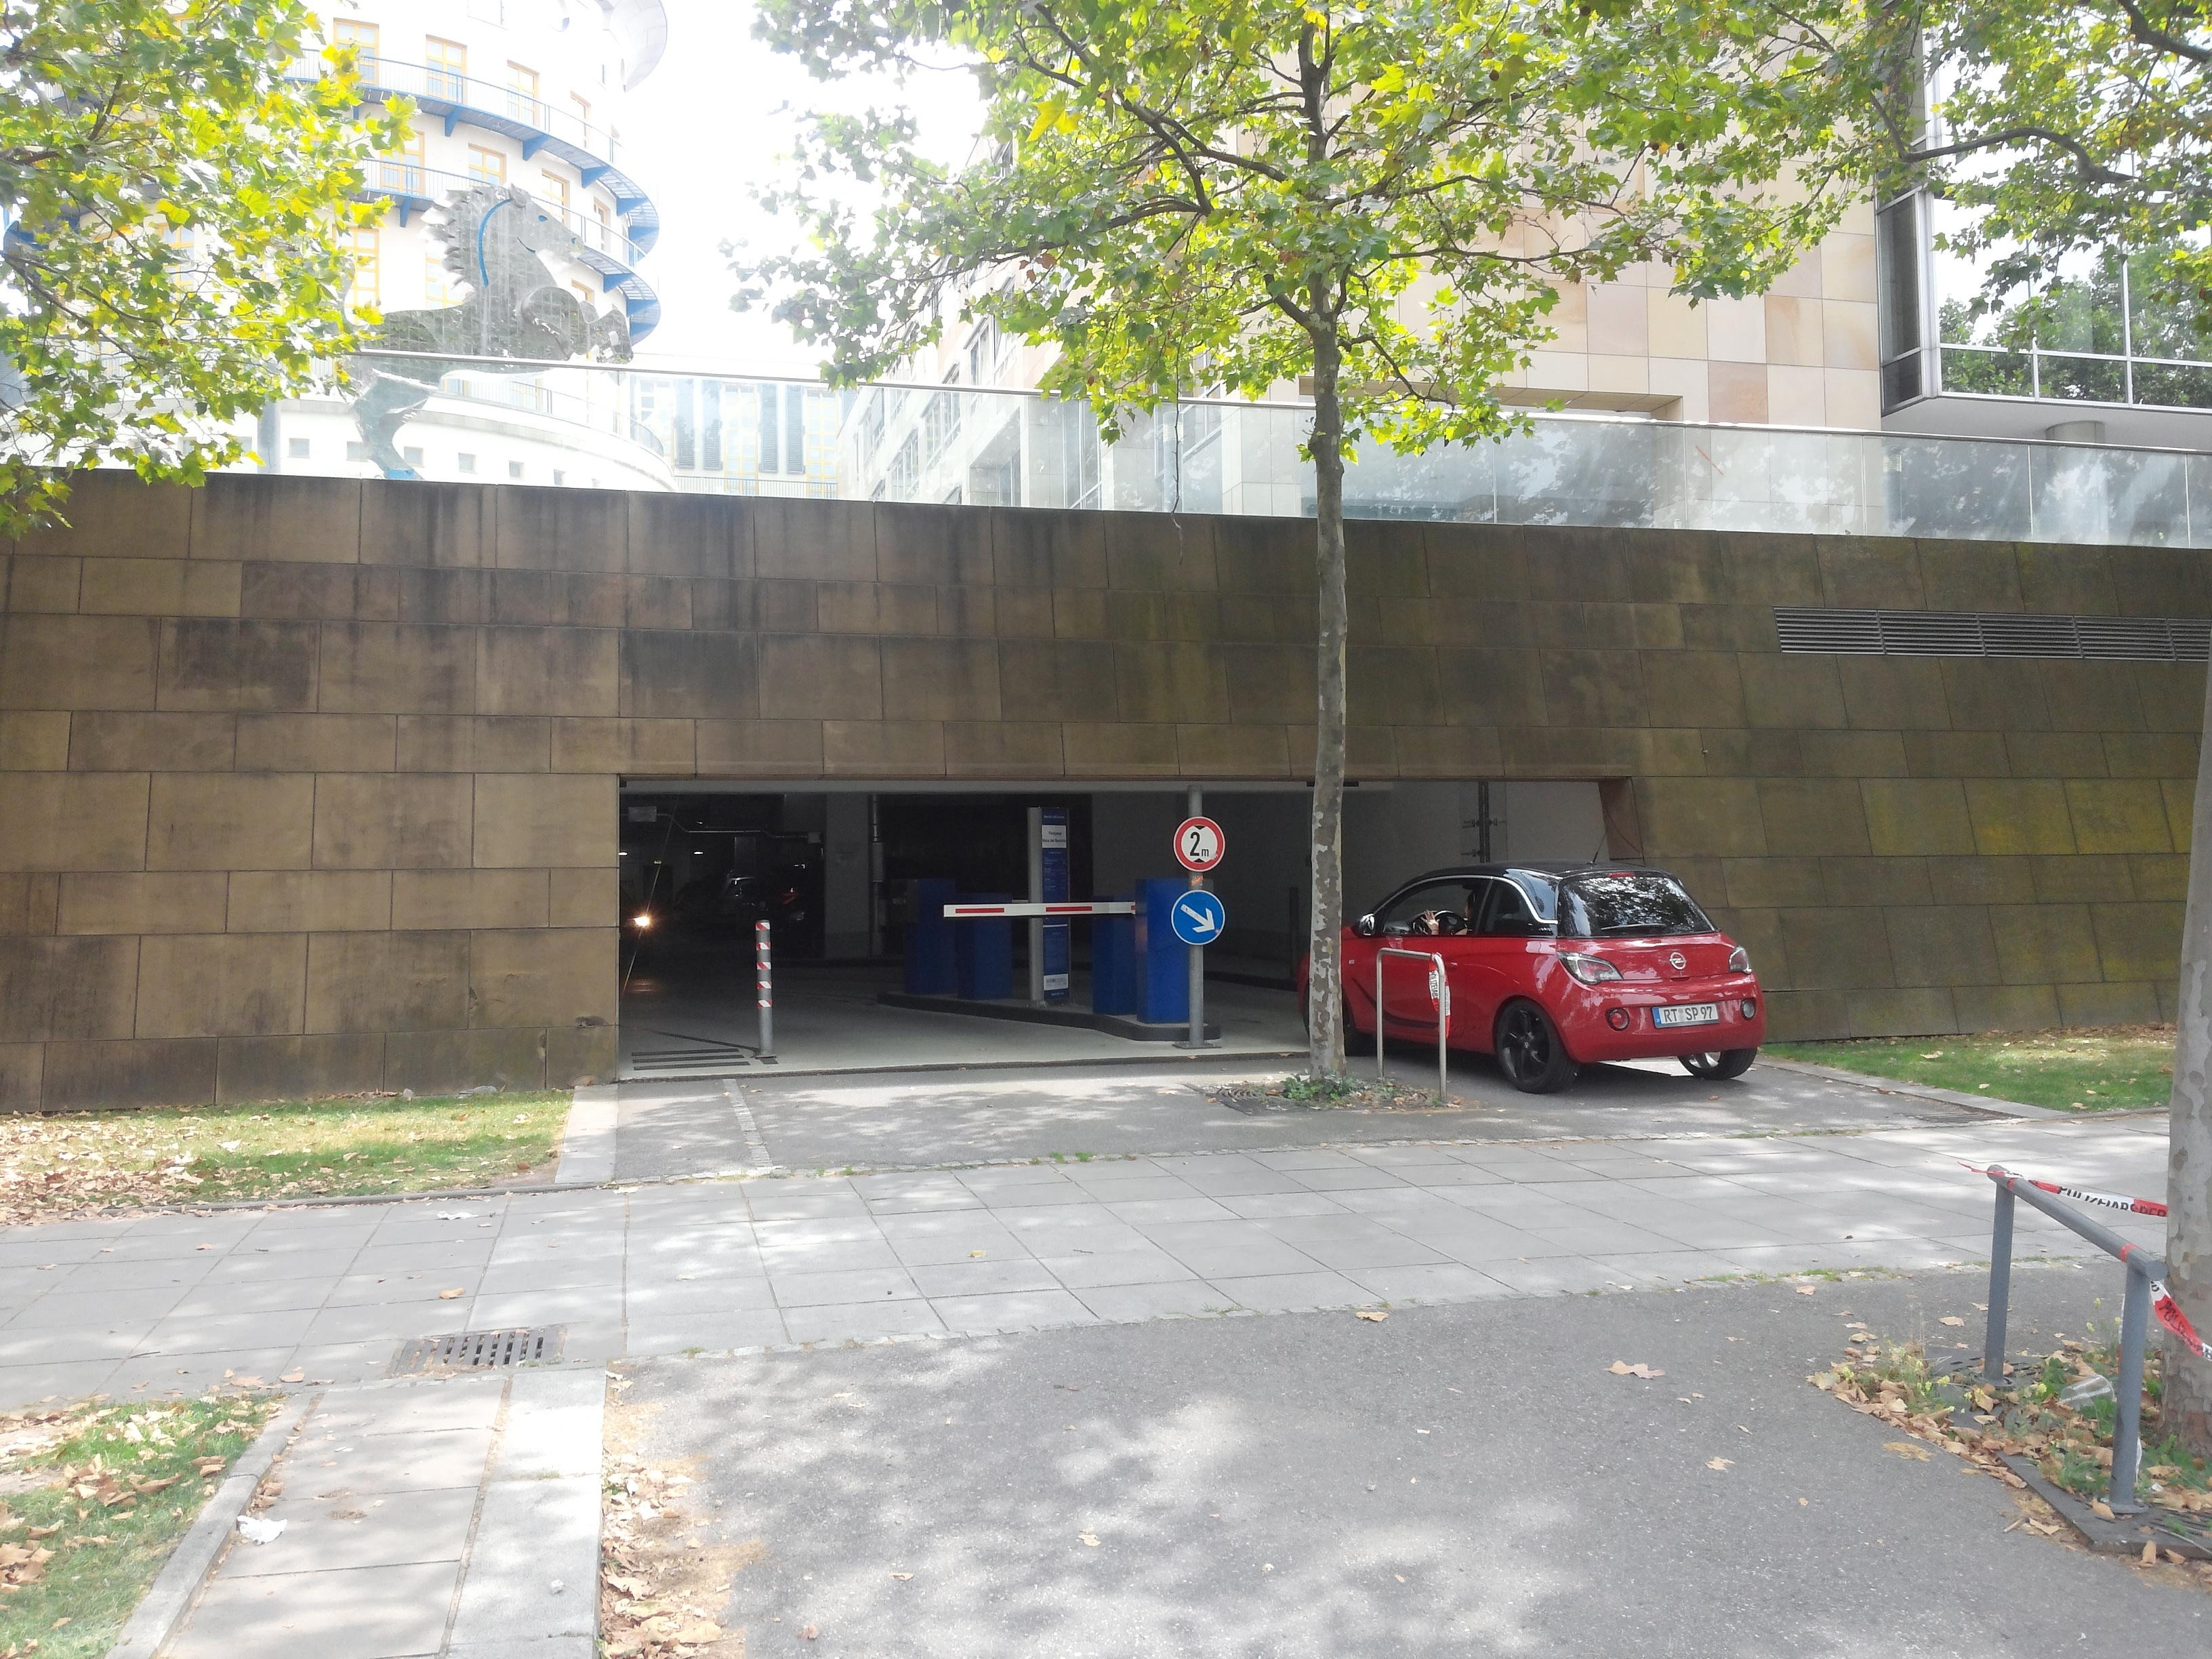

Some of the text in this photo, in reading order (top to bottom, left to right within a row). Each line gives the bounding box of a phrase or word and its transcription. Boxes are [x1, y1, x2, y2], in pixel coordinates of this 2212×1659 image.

[1664, 1006, 1712, 1022] RT SP 97
